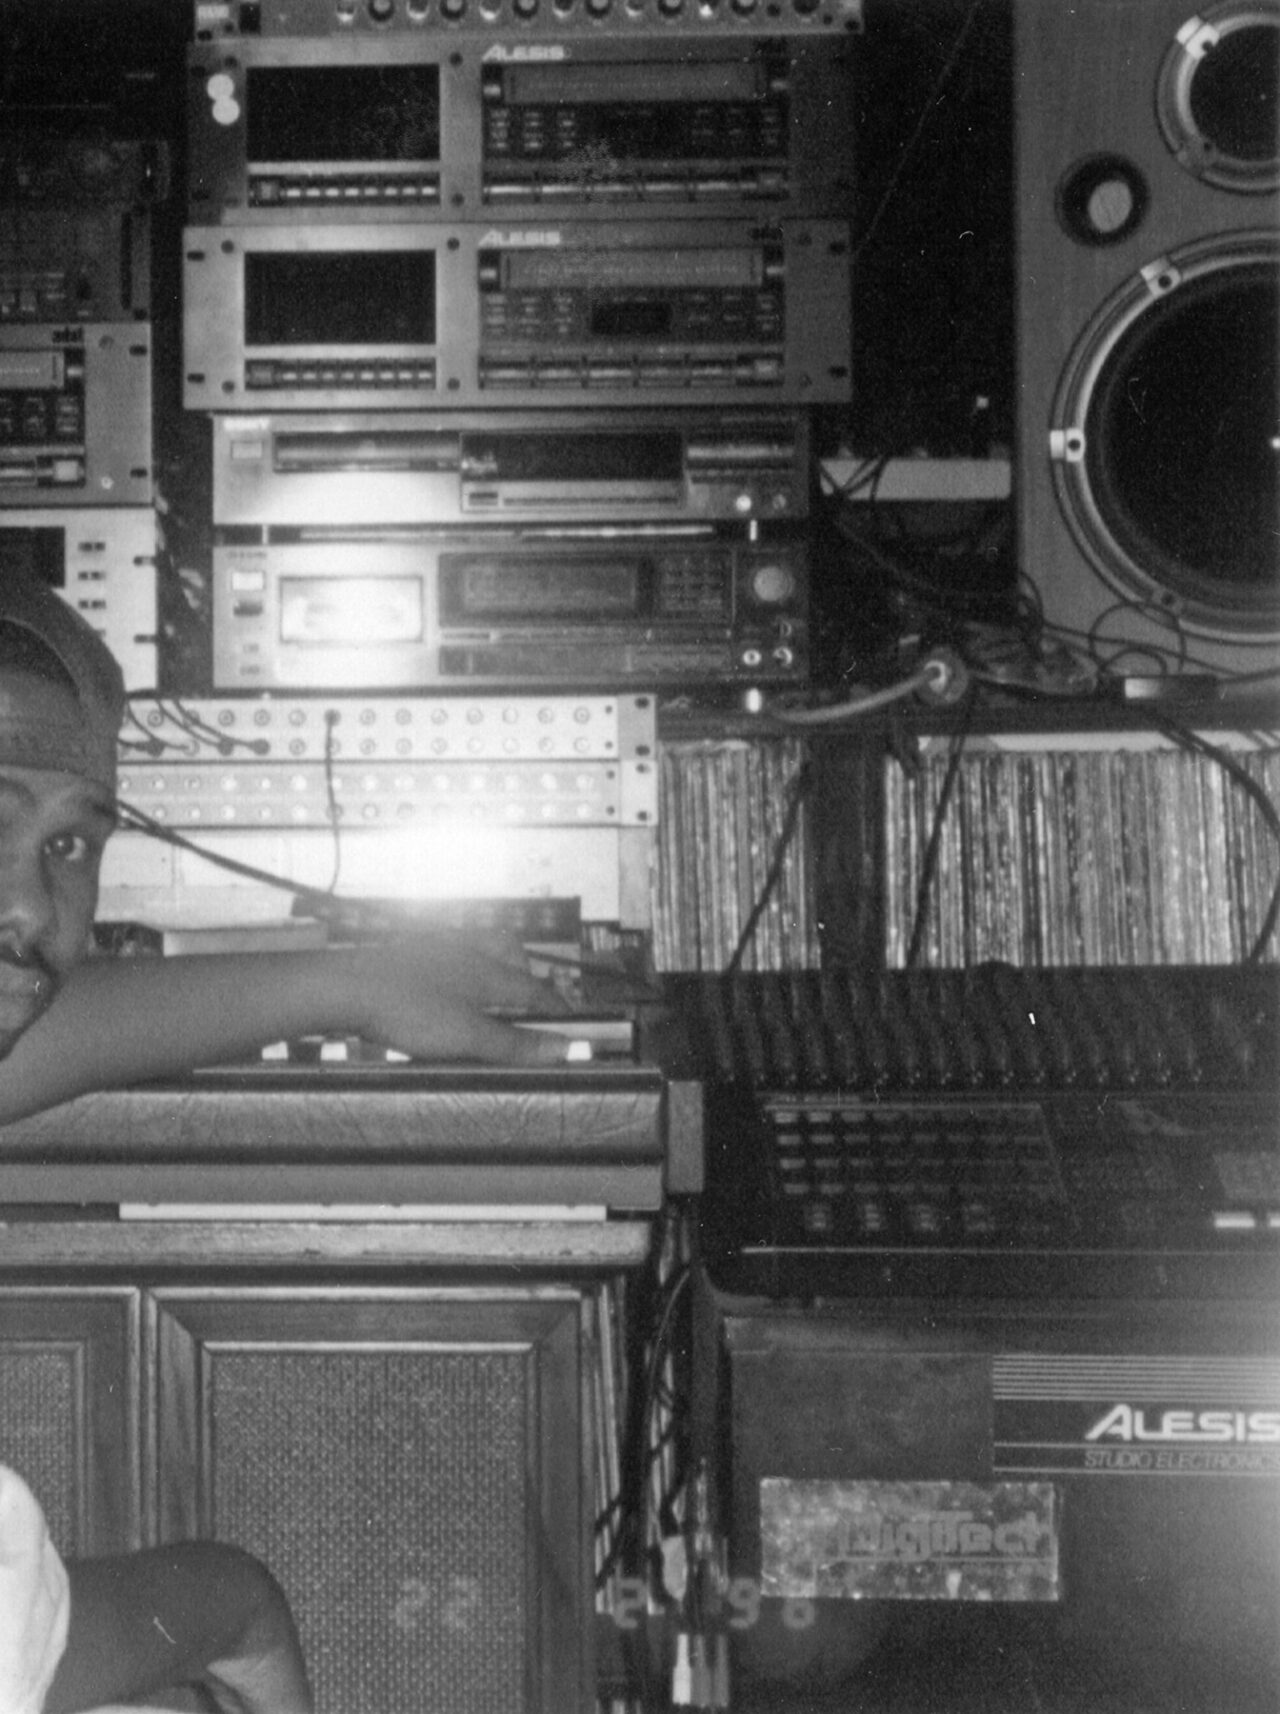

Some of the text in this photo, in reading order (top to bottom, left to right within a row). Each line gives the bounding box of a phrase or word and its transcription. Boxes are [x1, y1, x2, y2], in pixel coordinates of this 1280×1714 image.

[482, 43, 565, 61] ALESIS
[478, 228, 561, 246] ALESIS
[1085, 1403, 1280, 1442] ALESIS
[1085, 1450, 1153, 1469] STUDIO
